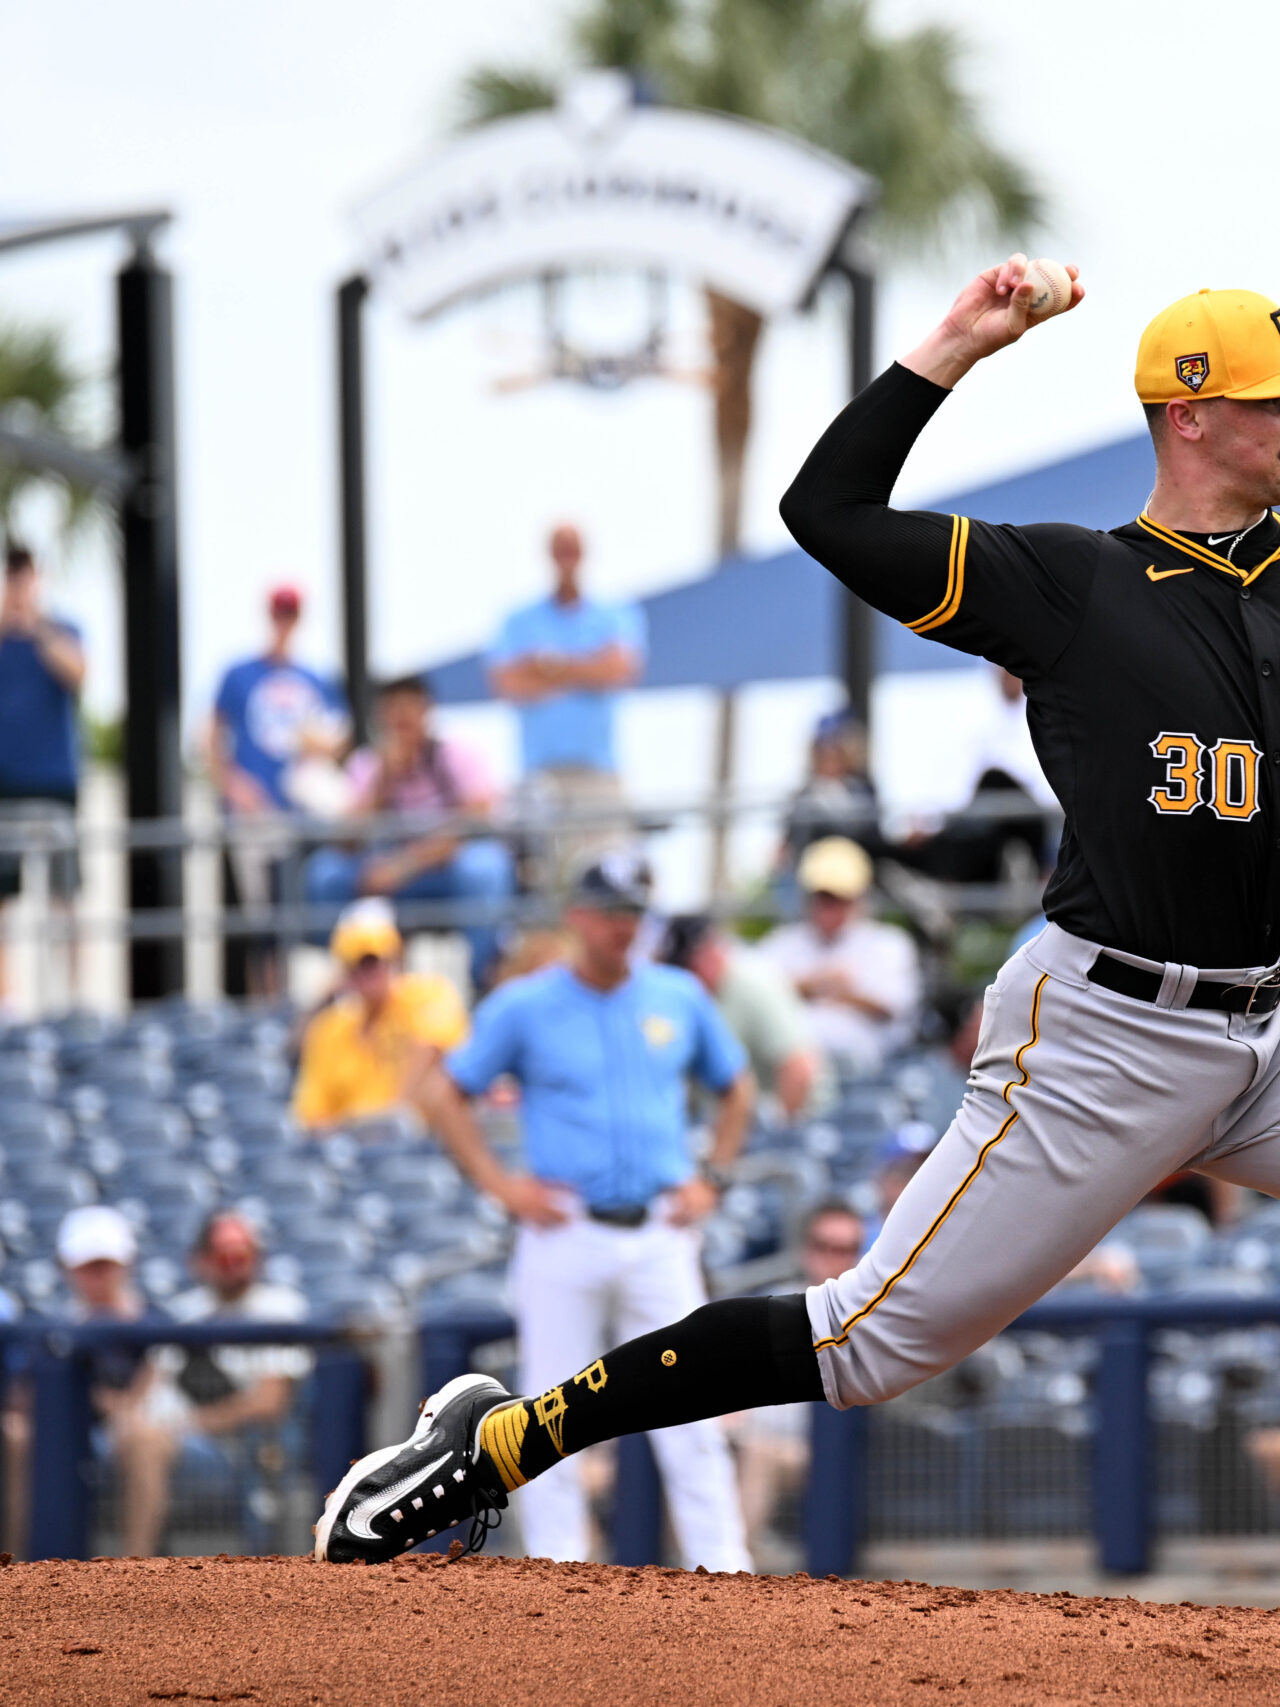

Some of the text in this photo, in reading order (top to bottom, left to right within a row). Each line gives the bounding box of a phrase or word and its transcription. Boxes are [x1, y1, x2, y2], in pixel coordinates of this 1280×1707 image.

[1181, 361, 1205, 377] 24
[1147, 731, 1264, 822] 30
[574, 1359, 608, 1393] P
